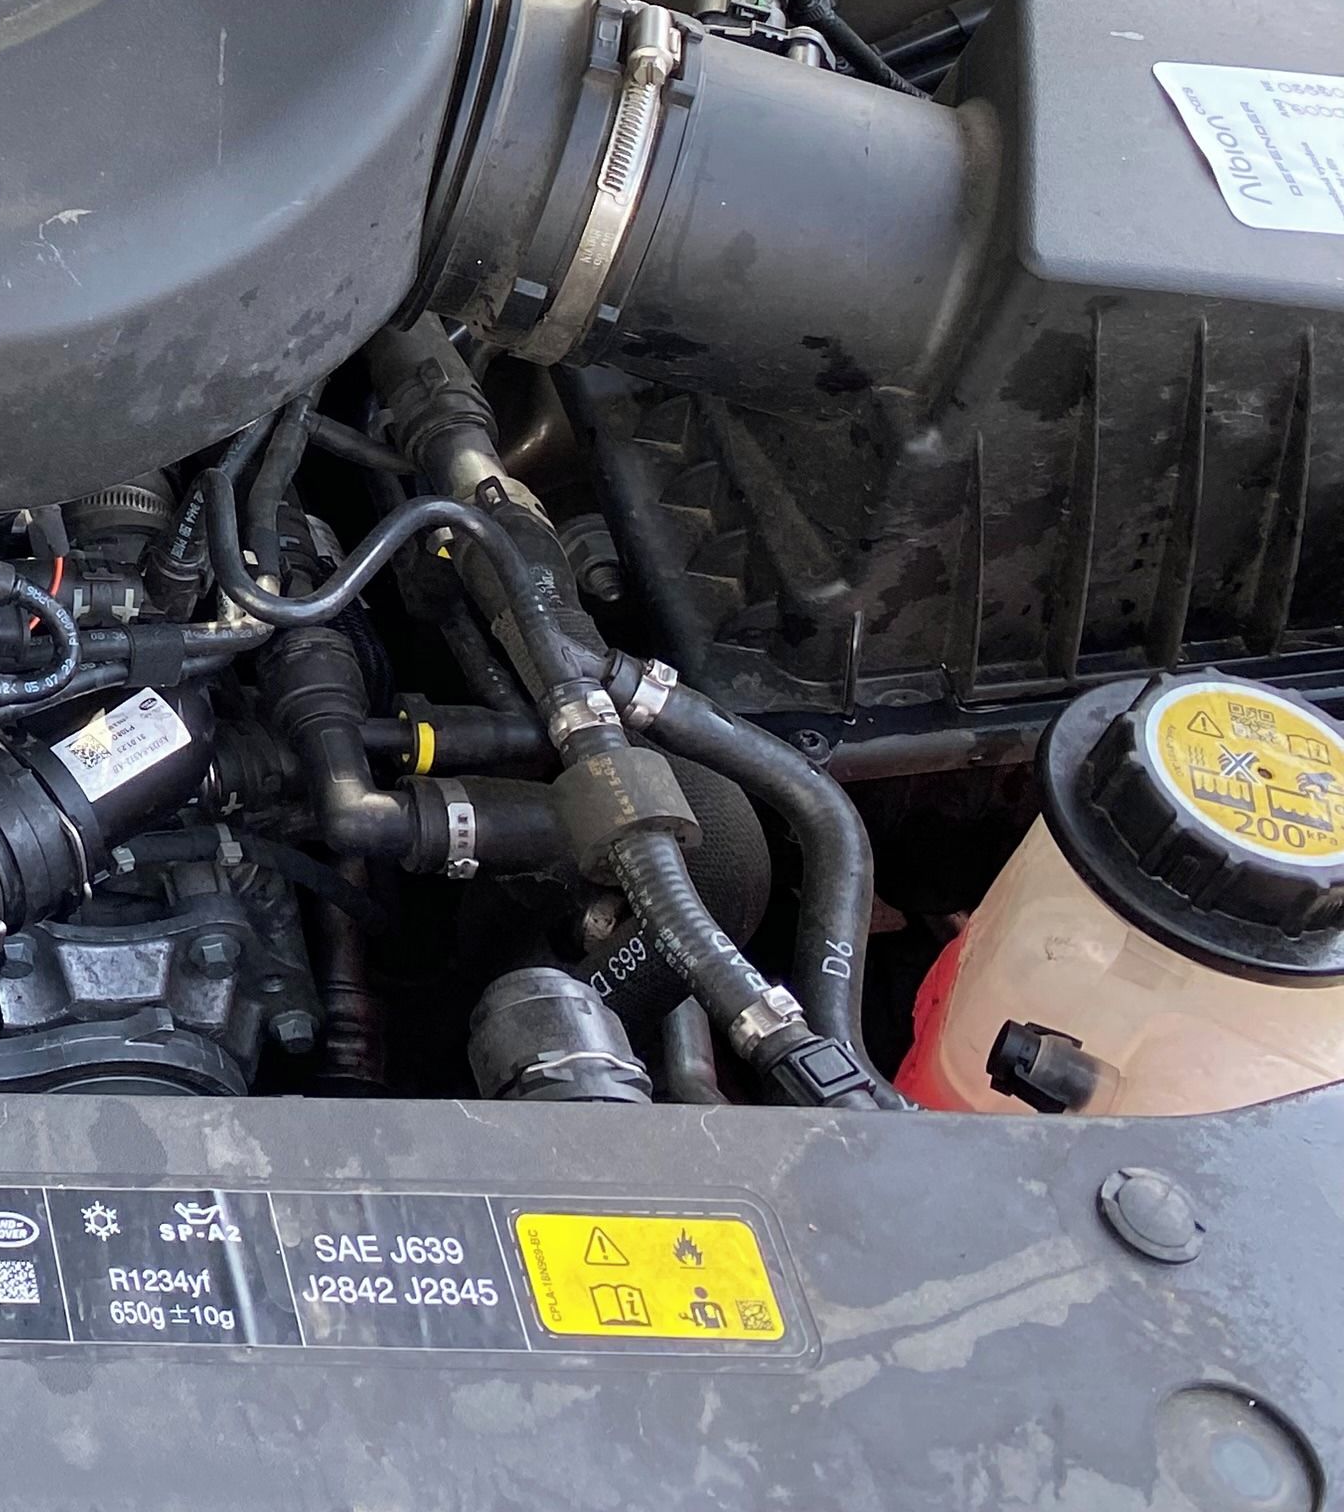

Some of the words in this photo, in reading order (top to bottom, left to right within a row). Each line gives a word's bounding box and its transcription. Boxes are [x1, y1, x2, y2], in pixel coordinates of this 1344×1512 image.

[1240, 101, 1304, 197] DEFENDER
[1232, 811, 1305, 849] 200
[1306, 829, 1338, 845] kPa
[609, 931, 647, 981] 663
[822, 939, 854, 979] D6
[159, 1223, 242, 1242] SP-A2
[313, 1234, 383, 1263] SAE
[390, 1235, 464, 1264] J639
[108, 1267, 211, 1298] R1234yf
[302, 1274, 398, 1304] J2842
[404, 1276, 499, 1306] J2845
[109, 1300, 166, 1330] 650g
